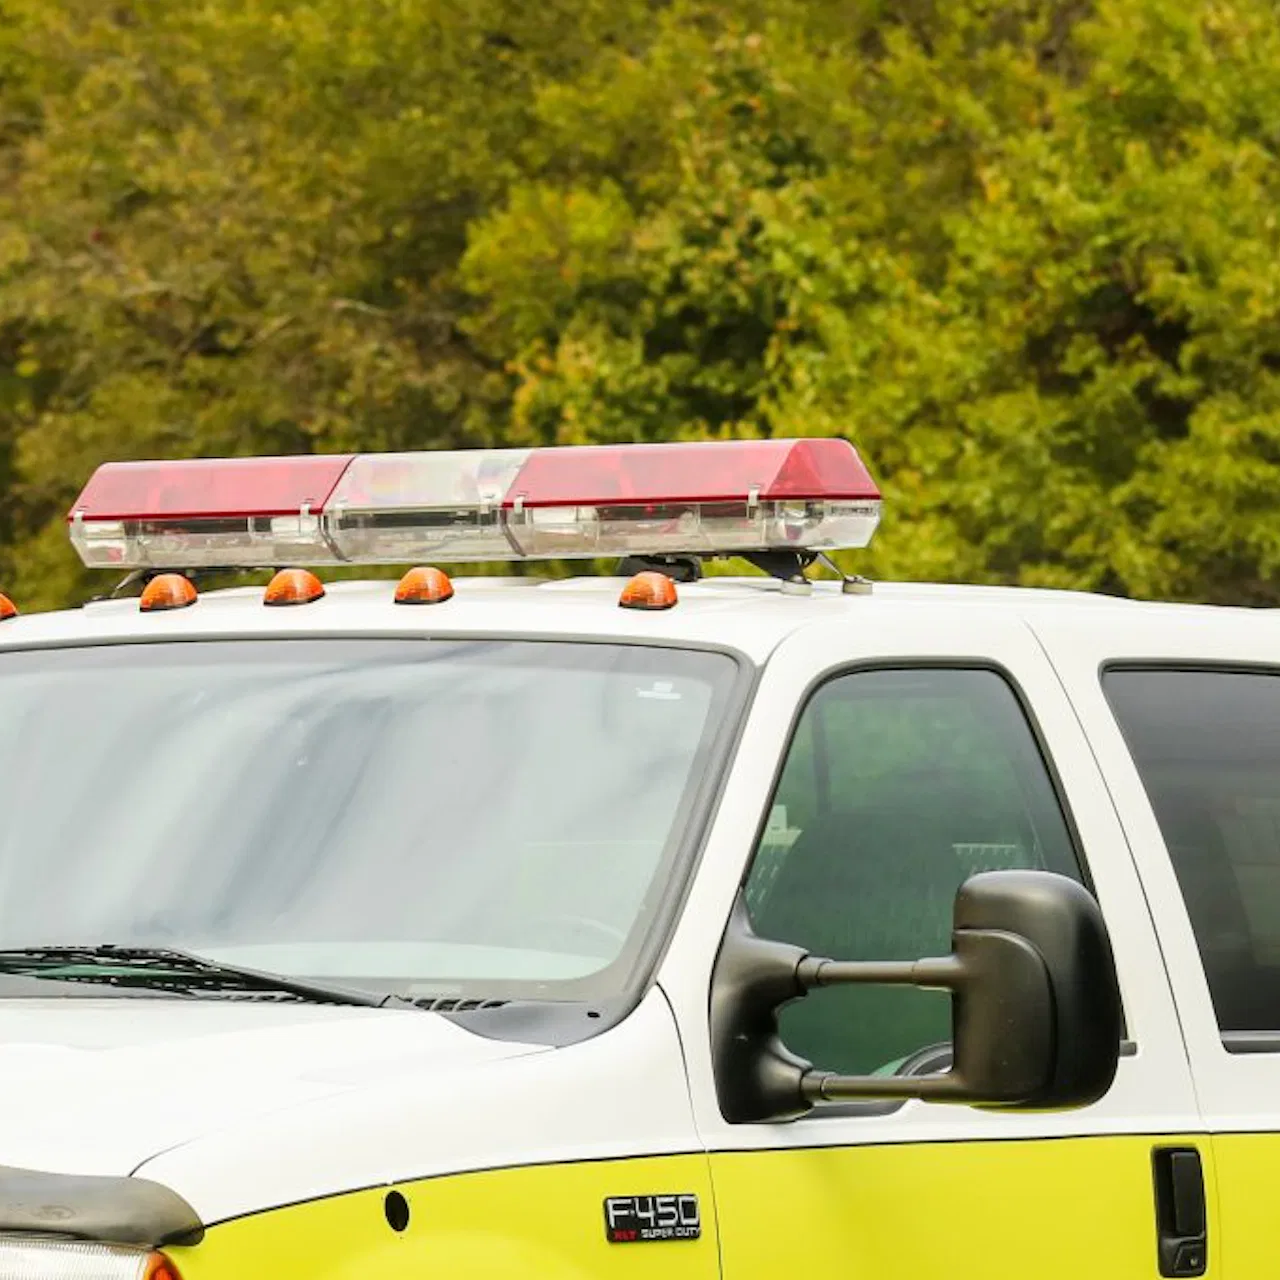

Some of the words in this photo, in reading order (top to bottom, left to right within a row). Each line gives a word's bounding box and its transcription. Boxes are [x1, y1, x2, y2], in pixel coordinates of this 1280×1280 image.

[607, 1196, 700, 1228] F-450
[641, 1228, 674, 1239] SUPER
[675, 1227, 700, 1237] DUTY
